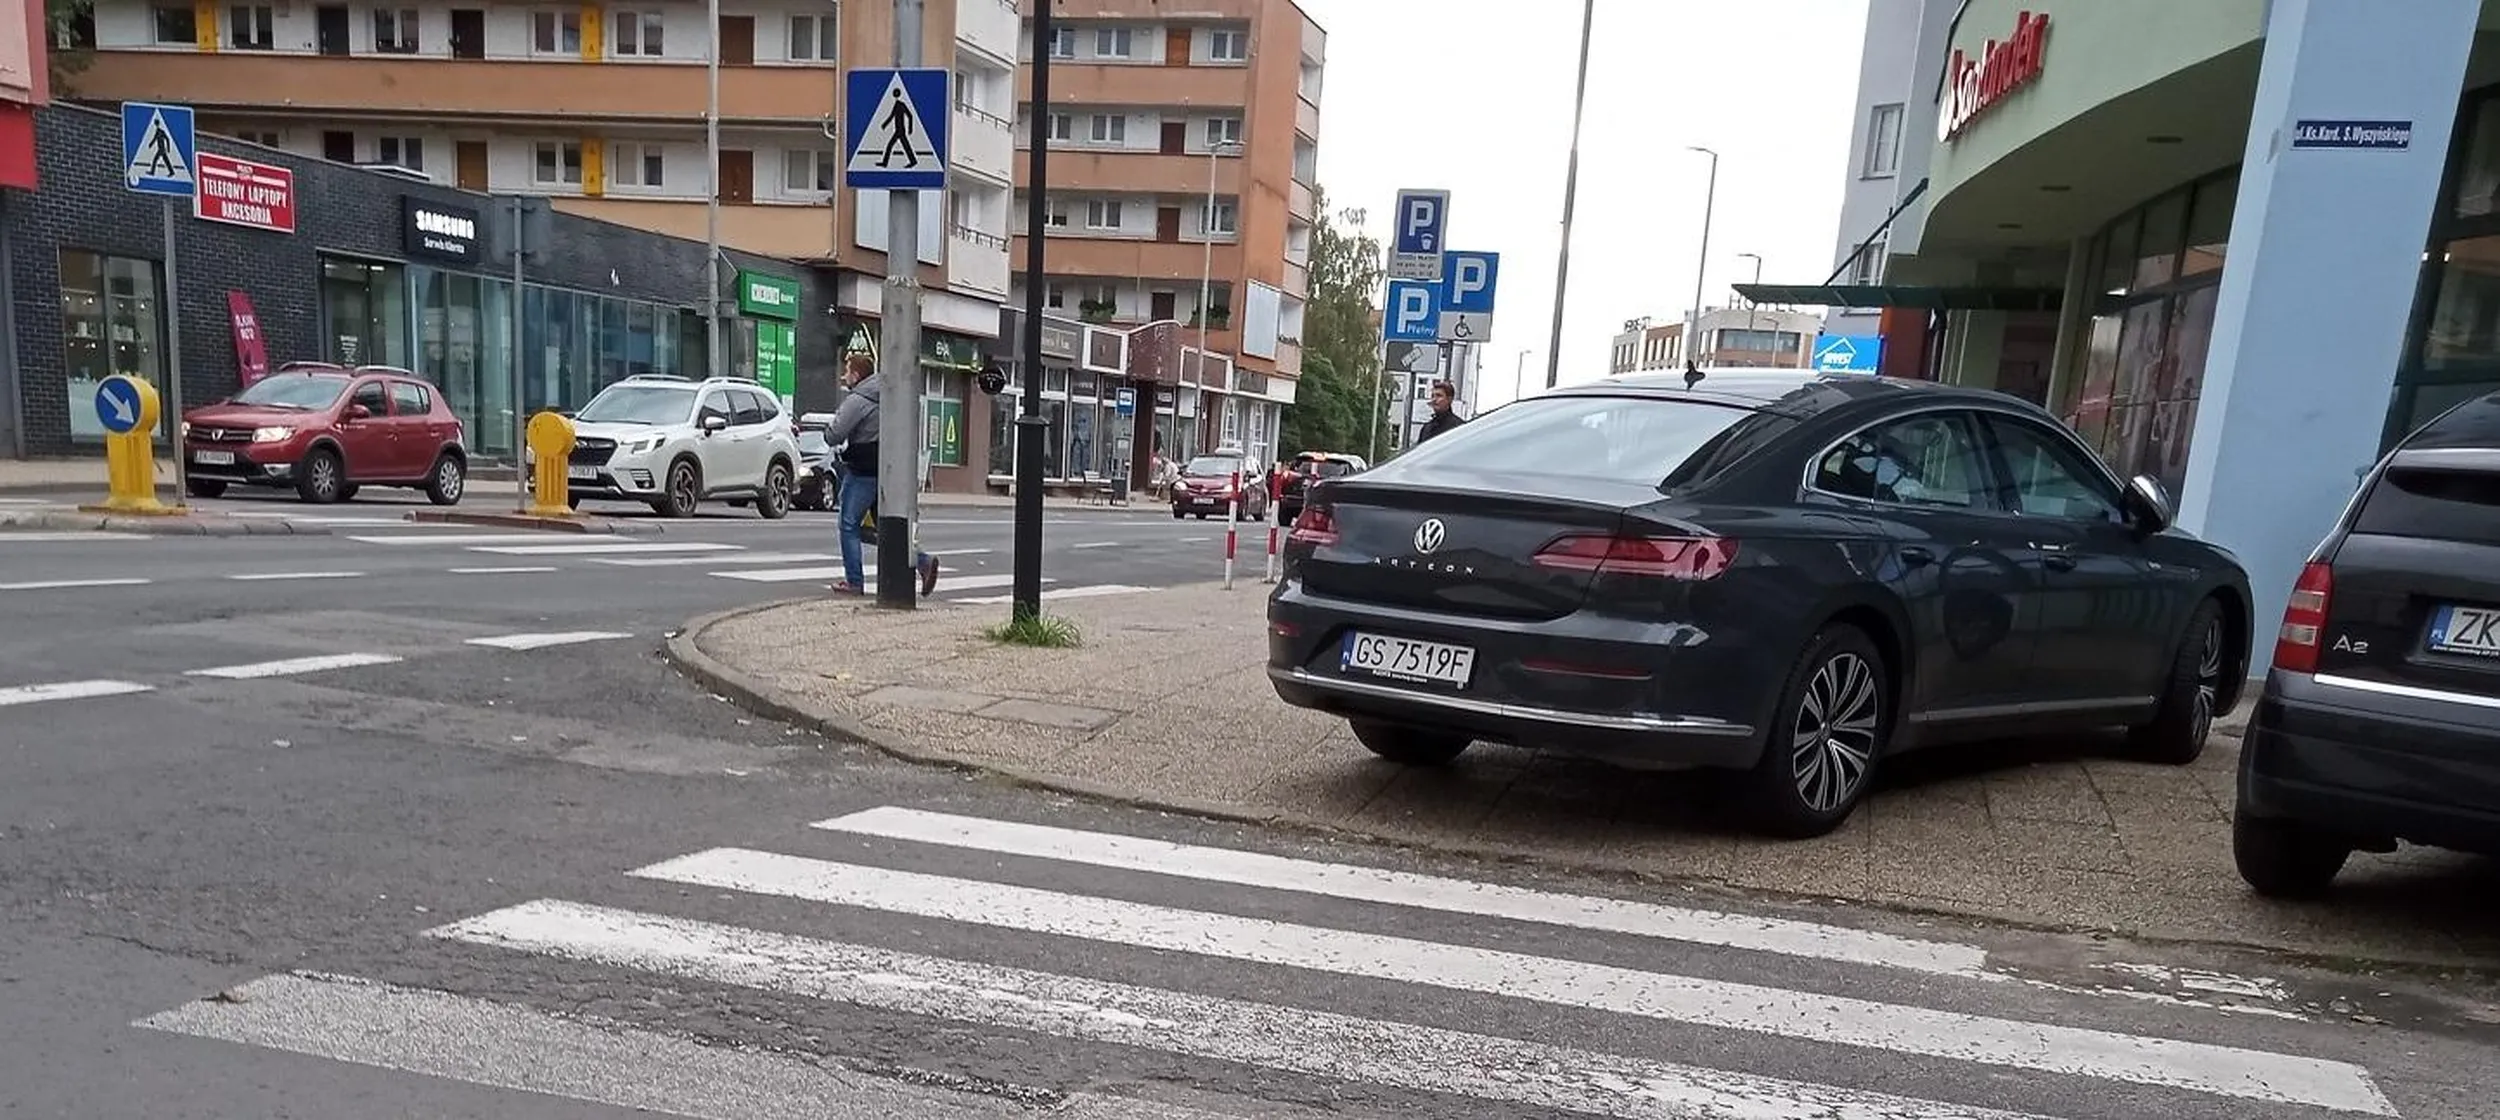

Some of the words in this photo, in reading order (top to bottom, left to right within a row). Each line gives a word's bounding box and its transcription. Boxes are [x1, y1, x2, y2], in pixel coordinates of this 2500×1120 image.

[1949, 10, 2049, 132] Santander
[203, 178, 245, 200] TELEFONY
[248, 185, 287, 208] LAPTOPY
[221, 201, 273, 224] AKCESORIA
[415, 209, 475, 240] SAMSUNG
[1408, 200, 1434, 236] P
[1454, 257, 1486, 303] P
[1397, 287, 1430, 333] P
[1373, 556, 1474, 574] ARTEON
[1355, 636, 1387, 666] GS
[1391, 641, 1469, 678] 7519F
[2333, 634, 2370, 654] A2
